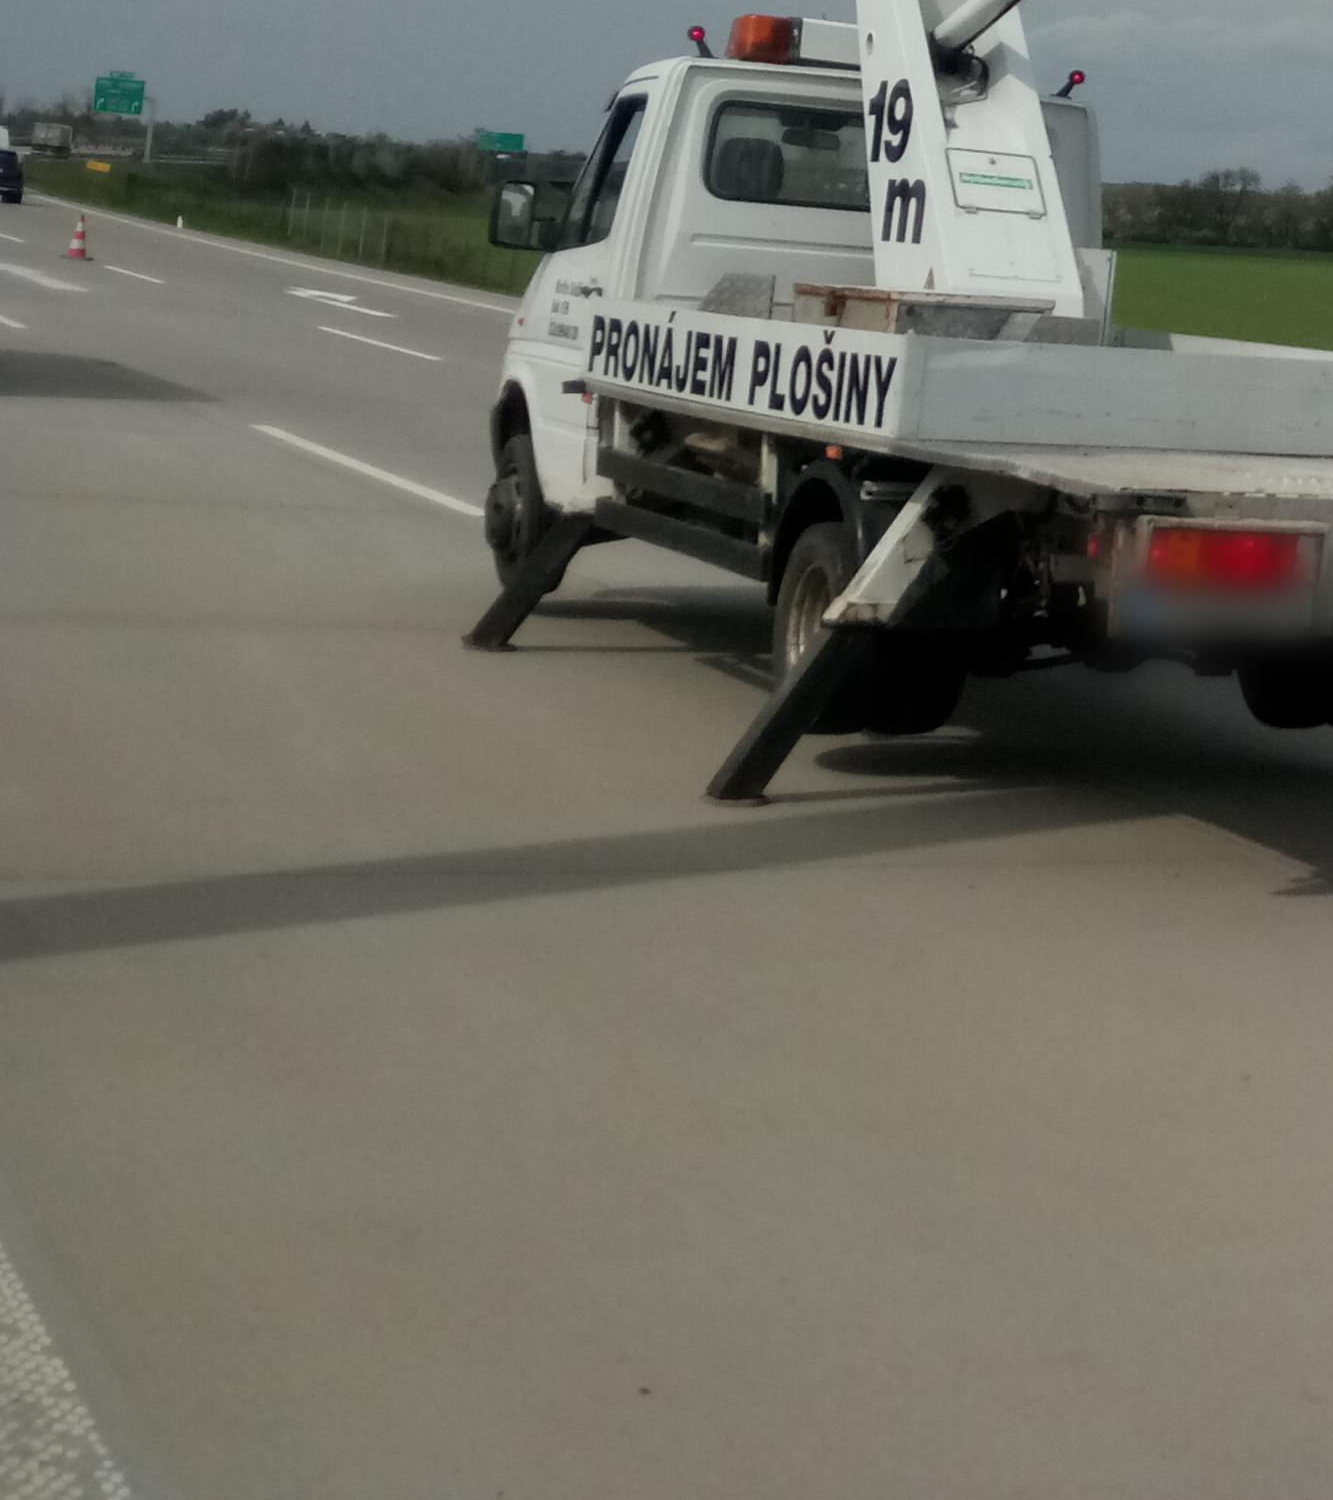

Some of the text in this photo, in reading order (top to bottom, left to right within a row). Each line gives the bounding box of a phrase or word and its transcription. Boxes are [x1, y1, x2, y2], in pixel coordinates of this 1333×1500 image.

[868, 78, 914, 163] 19
[881, 178, 926, 244] m
[588, 310, 898, 428] PRONÁJEM PLOŠINY
